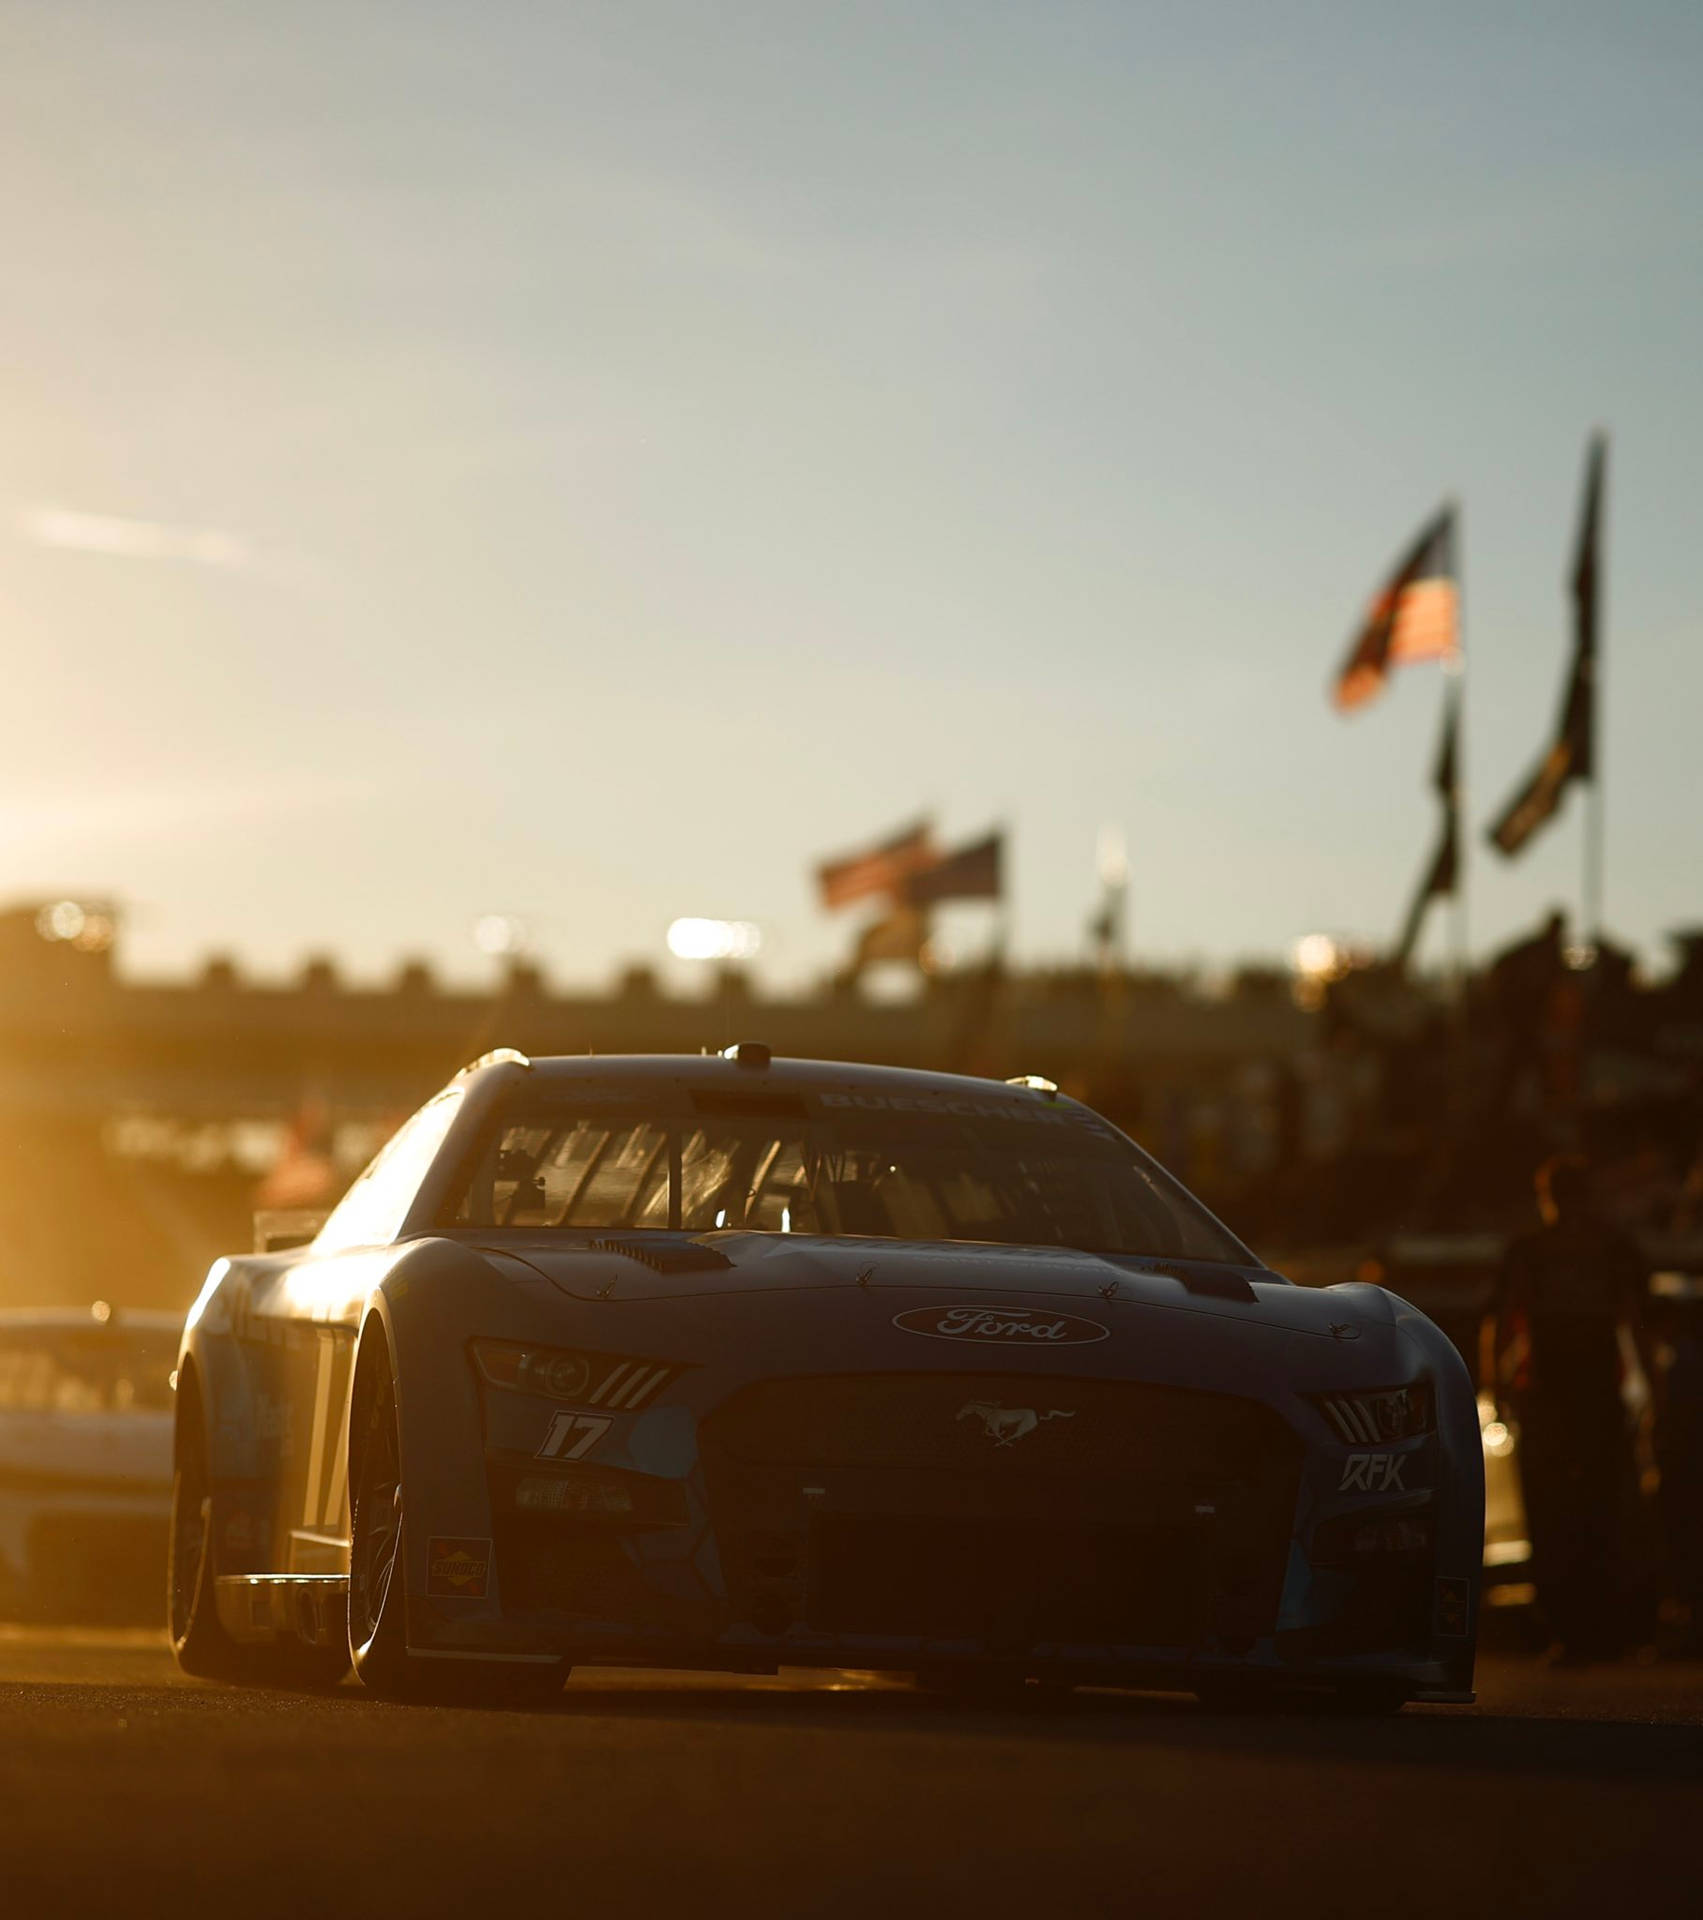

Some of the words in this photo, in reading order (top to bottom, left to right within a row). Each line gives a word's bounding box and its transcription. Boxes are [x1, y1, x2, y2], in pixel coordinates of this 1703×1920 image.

[820, 1093, 1066, 1124] BUESCHER
[936, 1307, 1068, 1339] Ford
[534, 1411, 615, 1461] 17
[1337, 1454, 1408, 1490] RFK
[433, 1561, 486, 1577] SUNOCO
